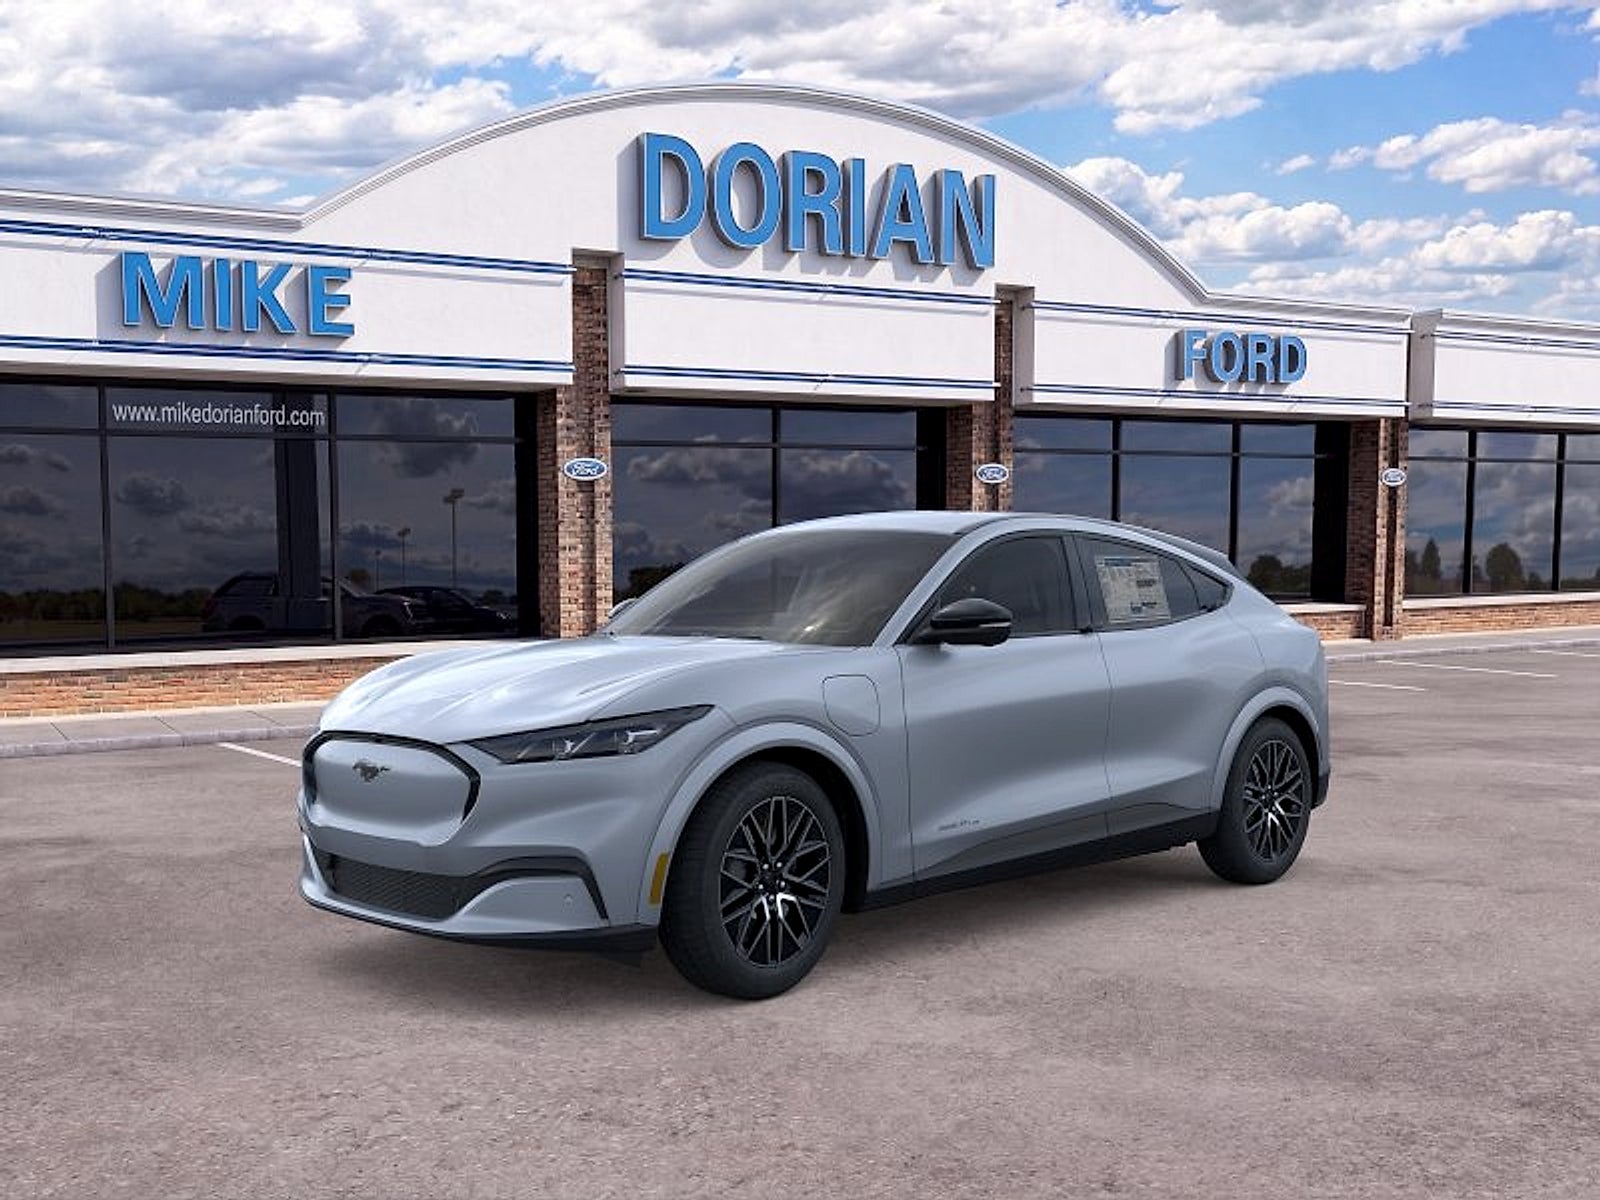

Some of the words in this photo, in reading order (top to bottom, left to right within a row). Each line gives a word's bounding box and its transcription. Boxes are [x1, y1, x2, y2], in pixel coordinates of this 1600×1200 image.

[640, 132, 996, 269] DORIAN
[121, 251, 355, 337] MIKE
[1180, 328, 1308, 384] FORD
[112, 402, 326, 426] www.mikedorianford.com
[571, 462, 600, 475] Ford
